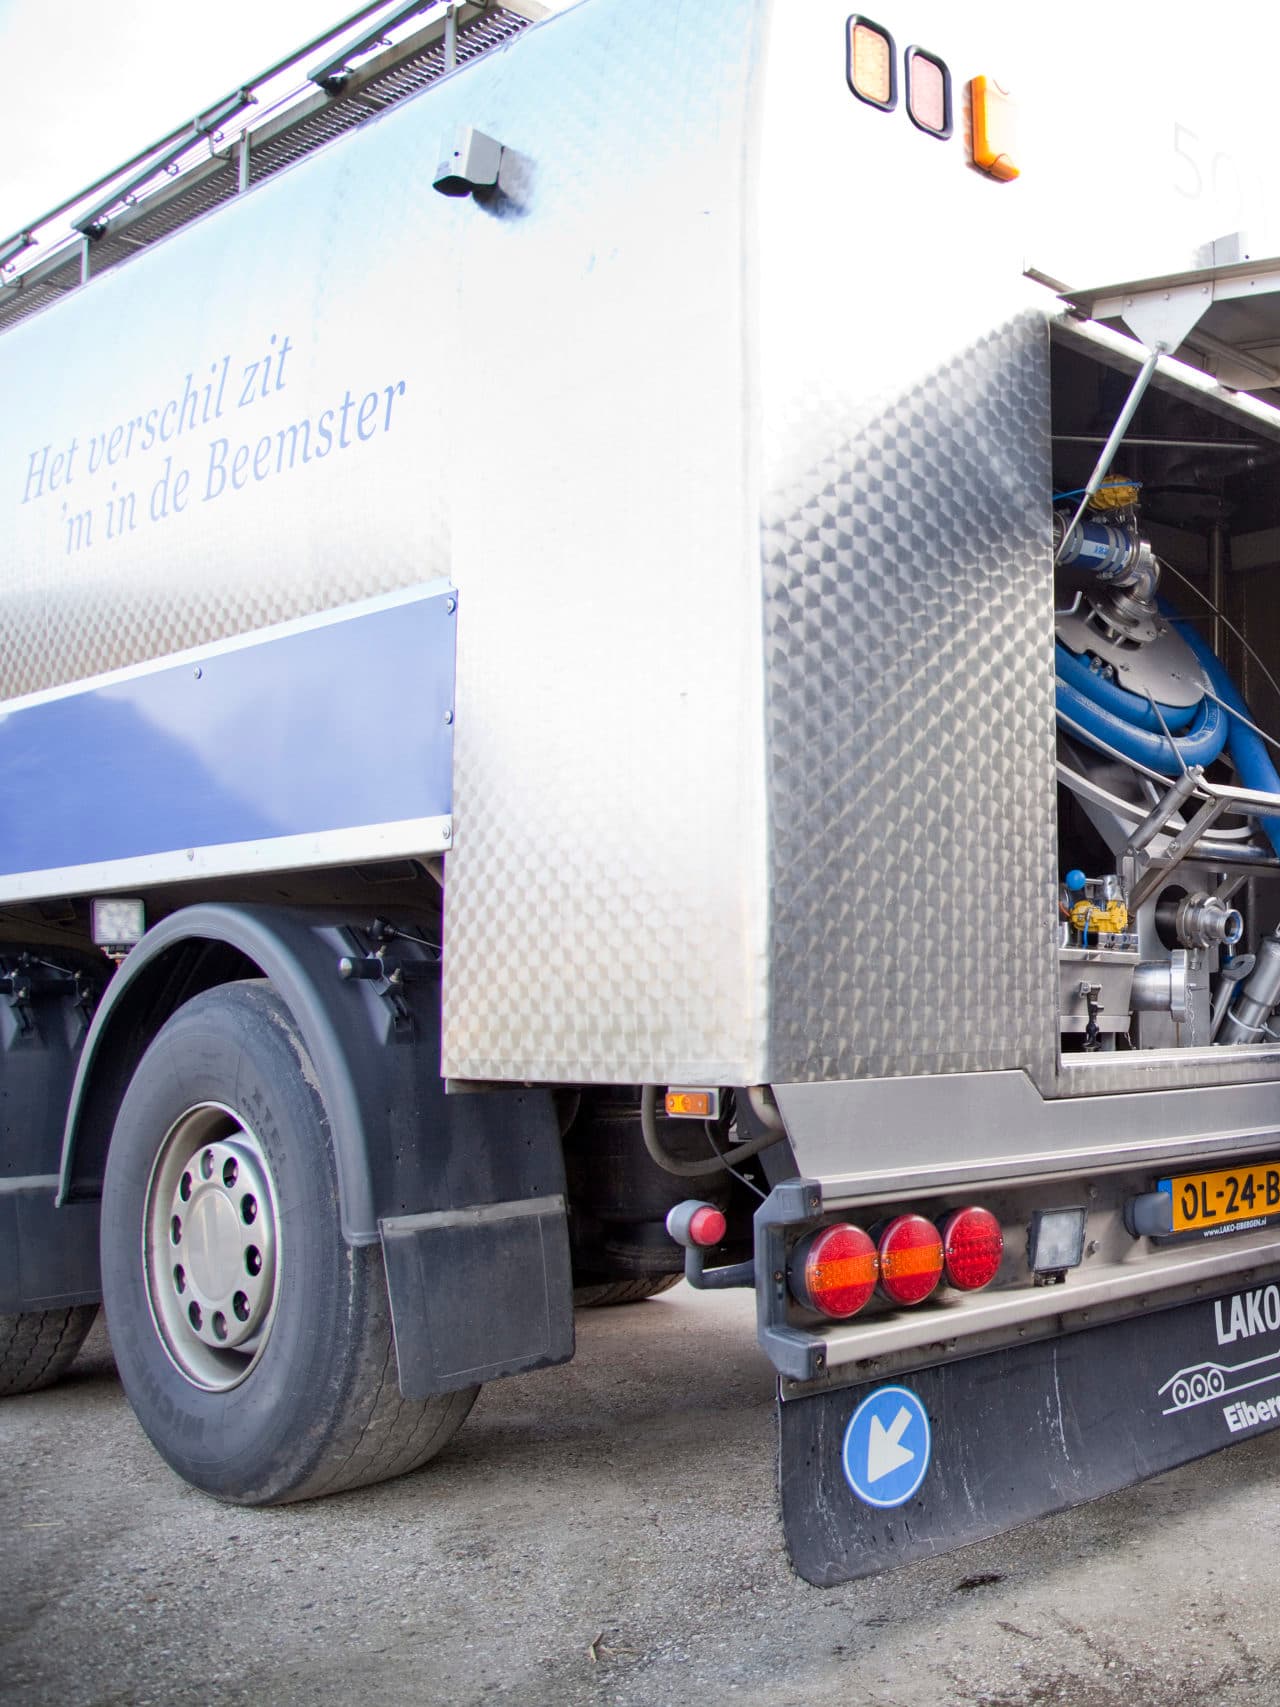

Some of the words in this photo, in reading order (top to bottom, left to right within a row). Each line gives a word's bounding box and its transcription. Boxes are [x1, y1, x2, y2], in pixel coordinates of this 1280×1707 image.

[22, 437, 79, 504] Het
[88, 355, 231, 474] verschil
[237, 333, 293, 408] zit
[105, 481, 136, 539] in
[150, 455, 190, 522] de
[202, 380, 407, 502] Beemster
